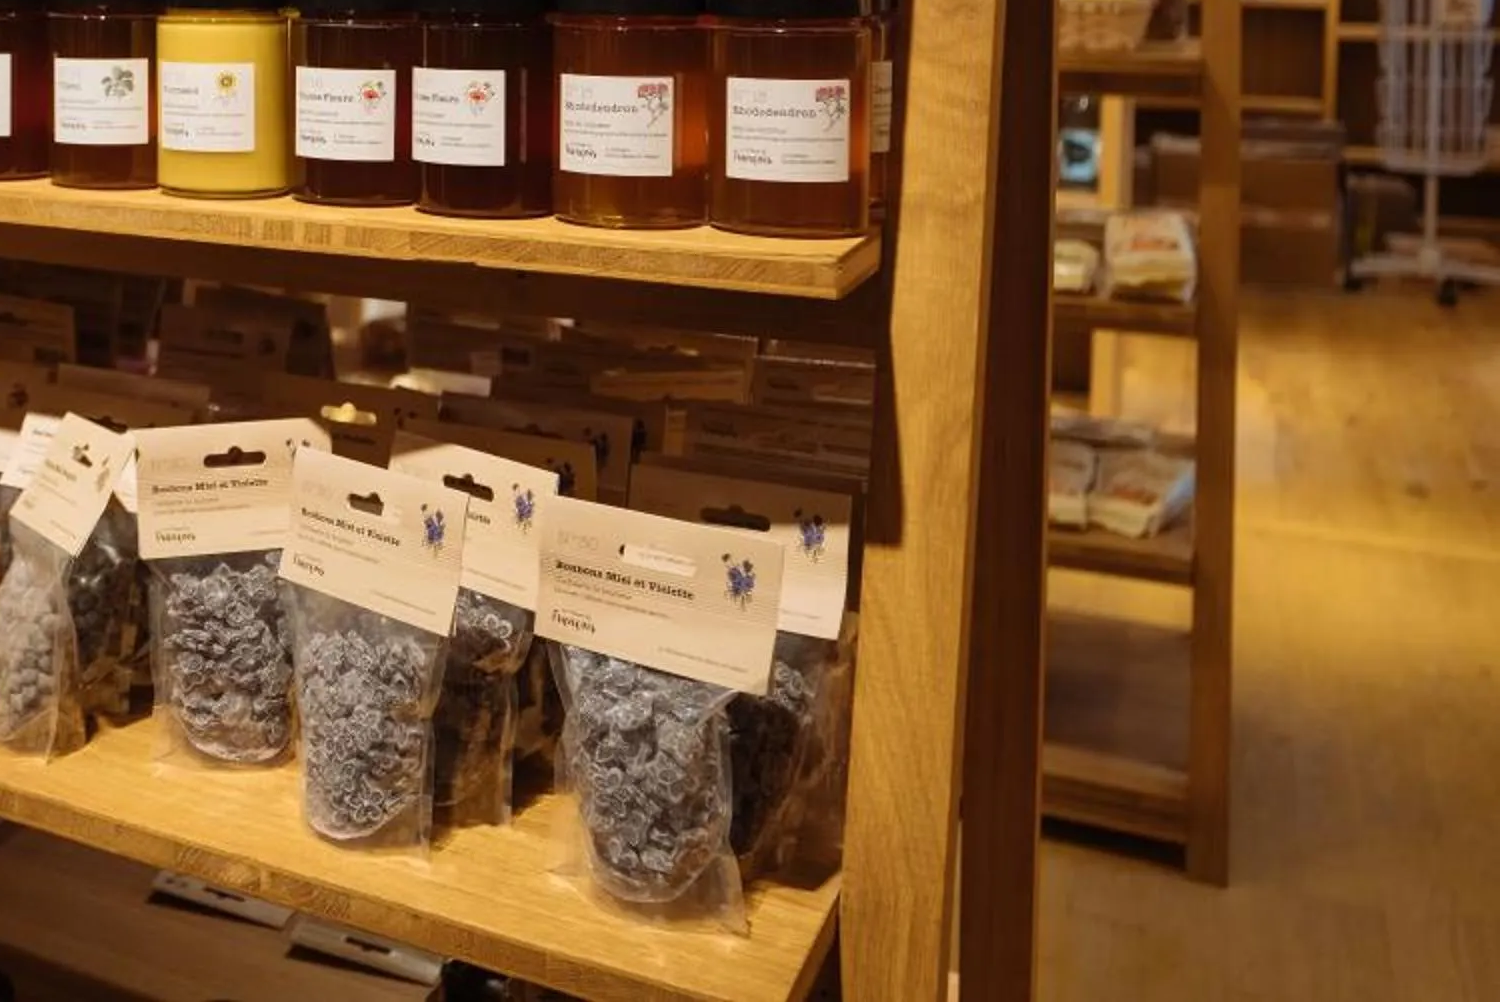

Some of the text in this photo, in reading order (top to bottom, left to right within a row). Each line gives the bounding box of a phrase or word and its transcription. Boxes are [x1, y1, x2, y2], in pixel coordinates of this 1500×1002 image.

[195, 480, 218, 492] Miel
[219, 481, 230, 490] et
[231, 477, 270, 489] Violette
[556, 560, 603, 580] Bonbons
[605, 570, 632, 586] Miel
[633, 578, 646, 590] et
[648, 580, 696, 601] Violette
